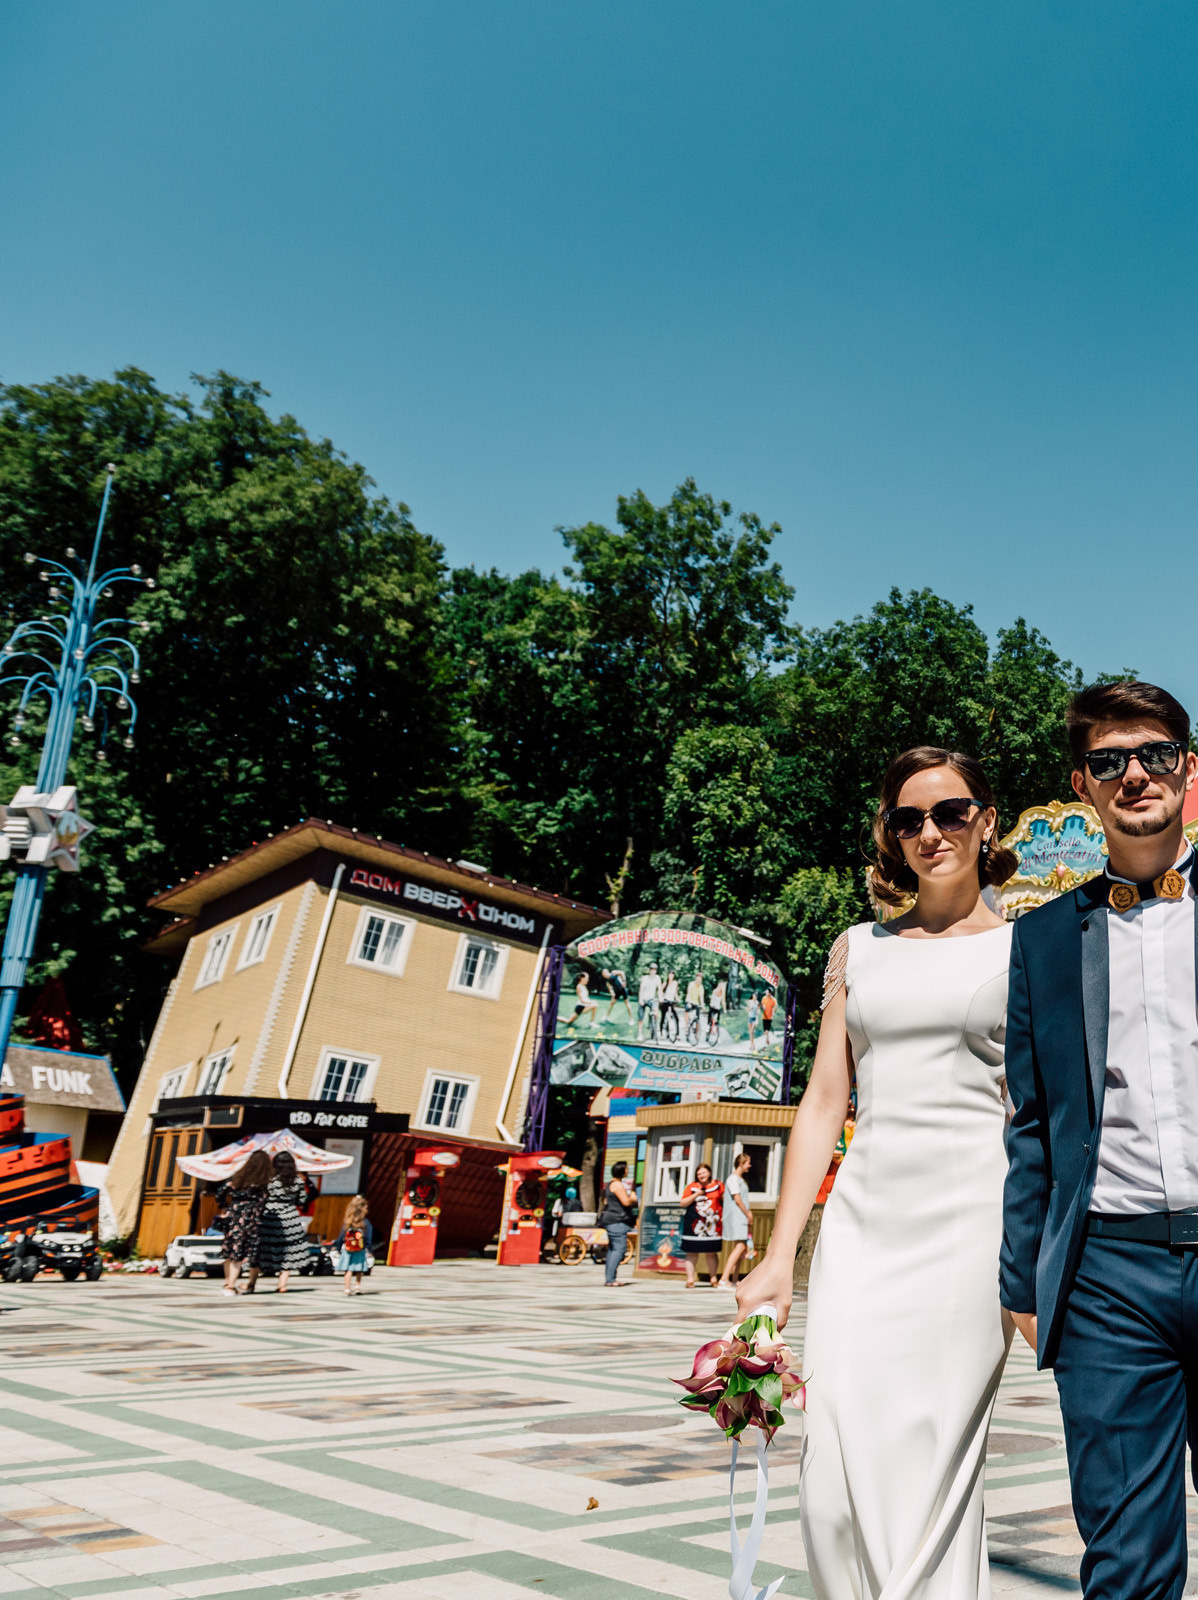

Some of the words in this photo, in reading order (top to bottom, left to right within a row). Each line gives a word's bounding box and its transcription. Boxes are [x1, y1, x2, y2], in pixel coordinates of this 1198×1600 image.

[1021, 857, 1032, 871] di
[350, 868, 401, 895] ДОМ
[403, 881, 478, 921] ВВЕРХ
[754, 960, 780, 989] ЗОНА
[641, 1049, 723, 1073] ДУБРАВА
[31, 1065, 94, 1095] FUNK
[289, 1111, 312, 1125] RED
[336, 1114, 369, 1128] COFFEE
